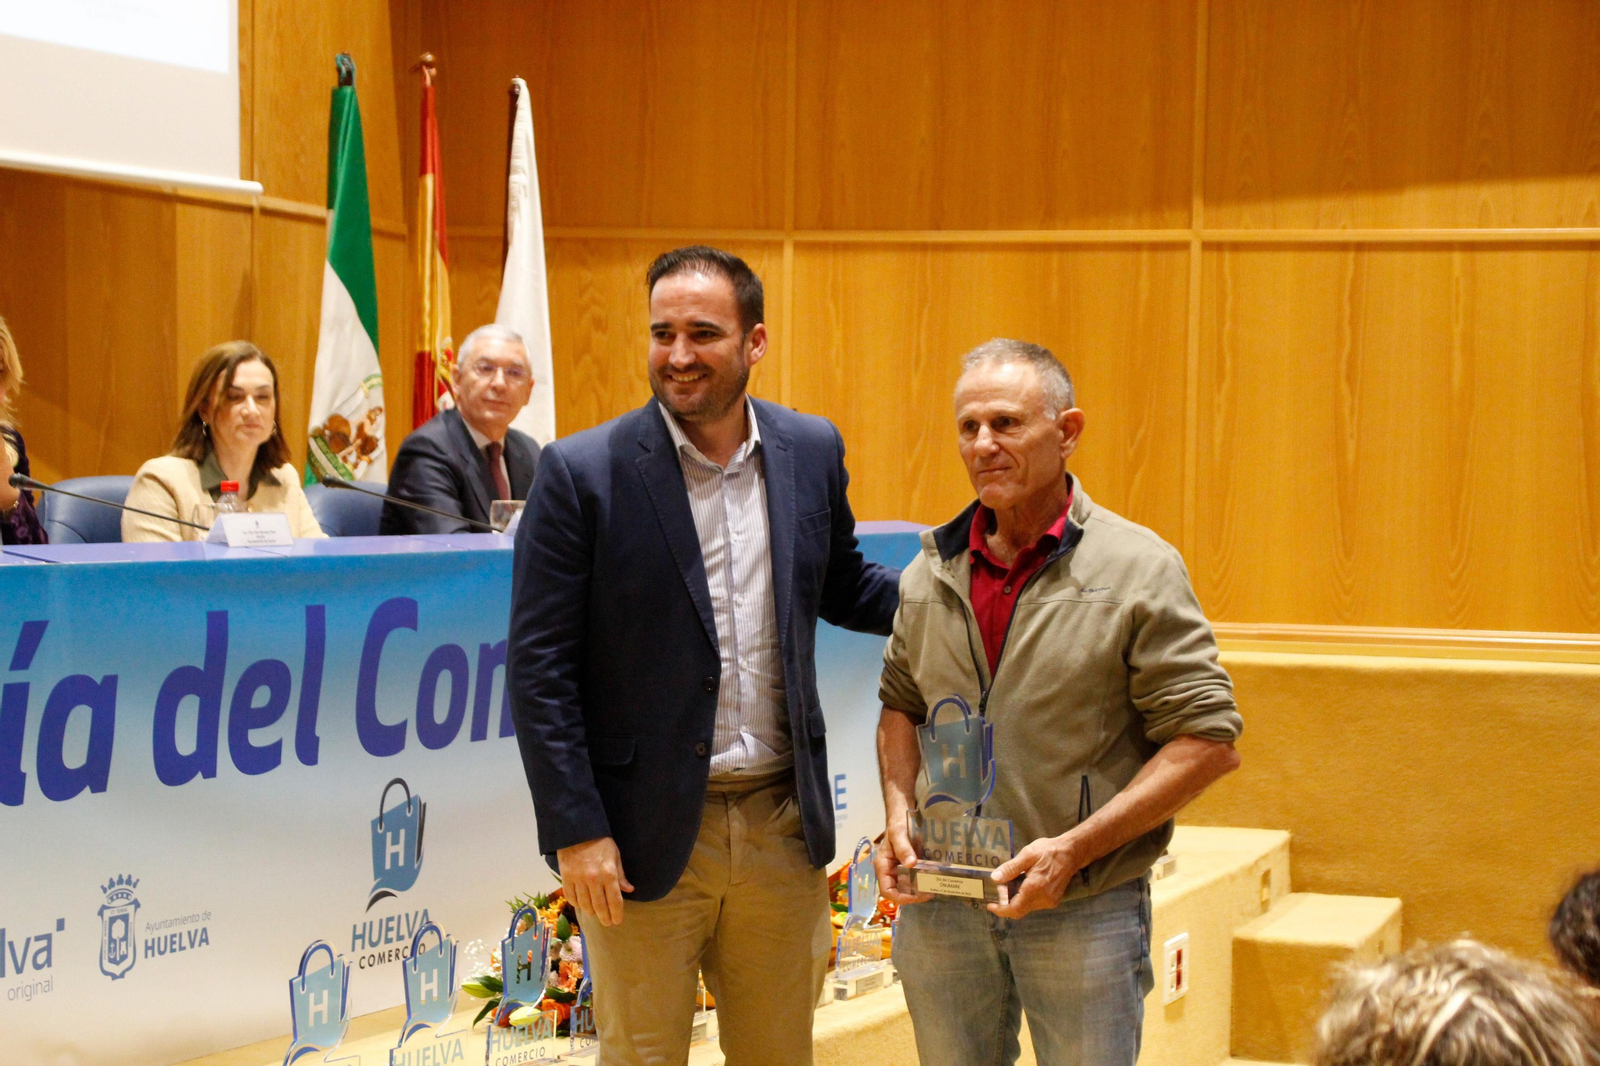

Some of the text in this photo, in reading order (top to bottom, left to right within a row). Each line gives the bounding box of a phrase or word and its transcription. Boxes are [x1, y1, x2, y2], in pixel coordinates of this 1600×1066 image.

[153, 604, 326, 787] del
[833, 774, 847, 811] E
[385, 828, 405, 870] H
[912, 817, 1011, 852] HUELVA
[923, 848, 1001, 868] COMERCIO
[145, 910, 212, 934] Ayuntamiento de
[351, 908, 434, 953] HUELVA
[144, 927, 210, 960] HUELVA
[358, 943, 426, 970] COMERCO
[8, 975, 53, 1002] original
[490, 1018, 552, 1054] HUELVA
[496, 1046, 545, 1066] COMERCIO
